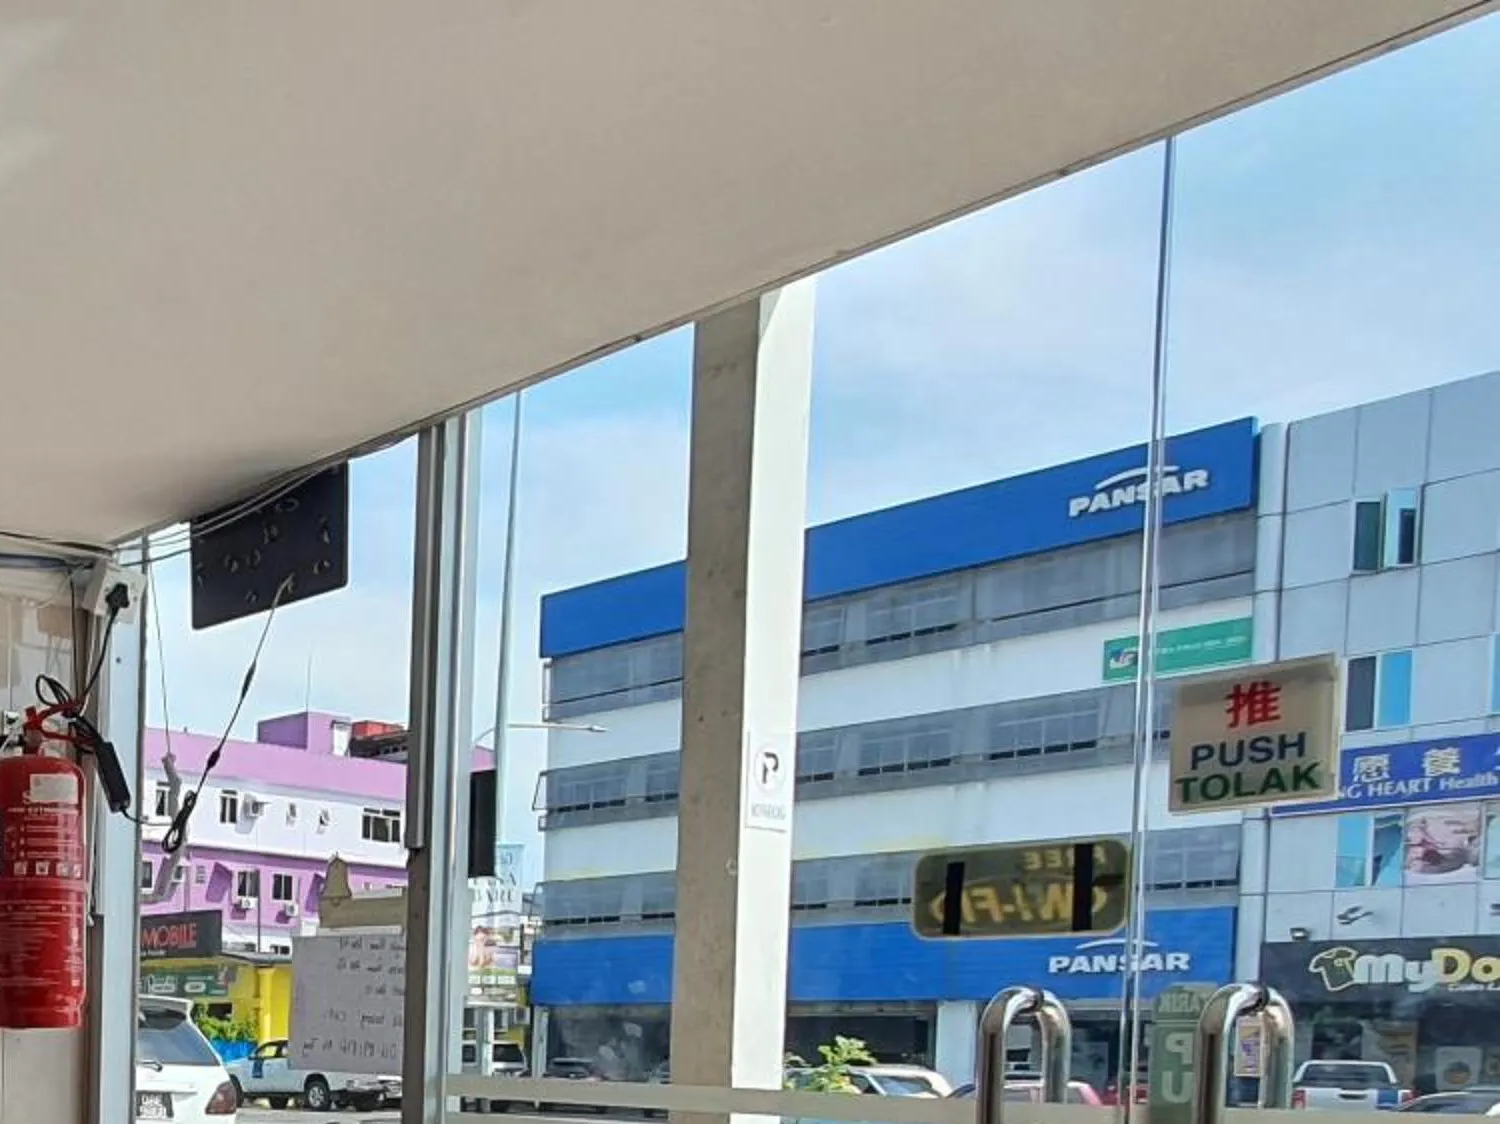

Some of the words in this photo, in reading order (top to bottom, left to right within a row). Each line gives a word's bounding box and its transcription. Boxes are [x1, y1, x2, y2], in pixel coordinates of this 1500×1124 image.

[1069, 469, 1209, 518] PANSAR
[1226, 680, 1282, 728] 推
[1190, 732, 1306, 770] PUSH
[1176, 761, 1322, 803] TOLAK
[1368, 777, 1433, 797] HEART
[1439, 771, 1499, 790] Health
[1048, 951, 1191, 974] PANSAR
